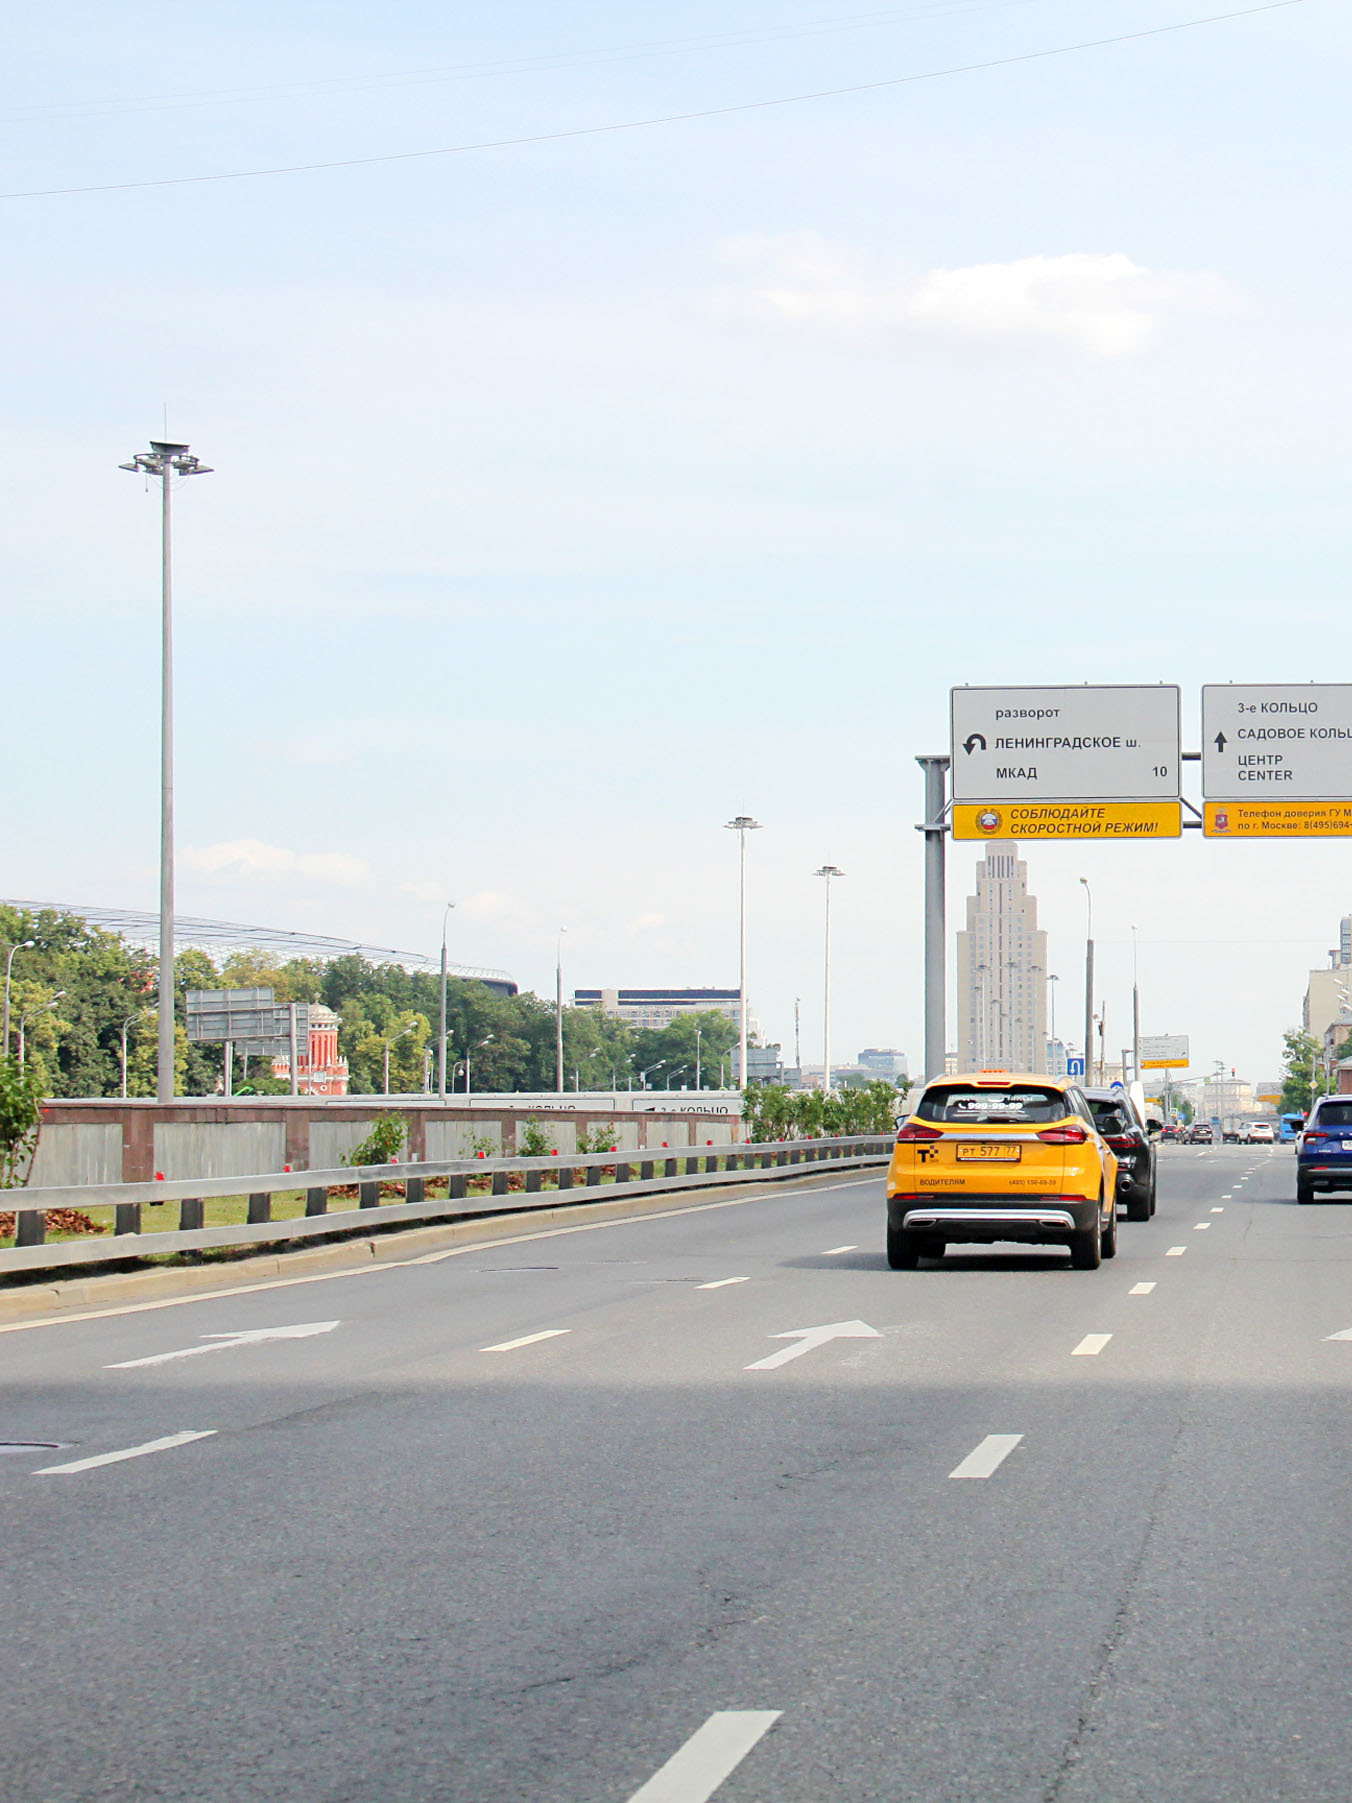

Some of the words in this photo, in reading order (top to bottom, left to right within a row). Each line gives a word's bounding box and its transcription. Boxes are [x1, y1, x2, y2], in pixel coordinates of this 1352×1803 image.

[995, 708, 1061, 719] разворот
[1238, 703, 1257, 713] 3-е
[1261, 702, 1318, 714] КОЛЬЦО
[1238, 728, 1305, 740] САДОВОЕ
[995, 737, 1121, 749] ЛЕНИНГРАДСКОЕ
[1126, 739, 1141, 748] ш.
[1238, 755, 1283, 767] ЦЕНТР
[996, 768, 1037, 779] МКАД
[1153, 766, 1168, 777] 10
[1238, 770, 1293, 781] CENTER
[1010, 808, 1105, 819] СОБЛЮДАЙТЕ
[1238, 810, 1281, 818] Телефон
[1329, 809, 1340, 817] ГУ
[1010, 822, 1101, 834] СКОРОСТНОЙ
[1105, 822, 1158, 833] РЕЖИМ!
[980, 1146, 999, 1156] 577
